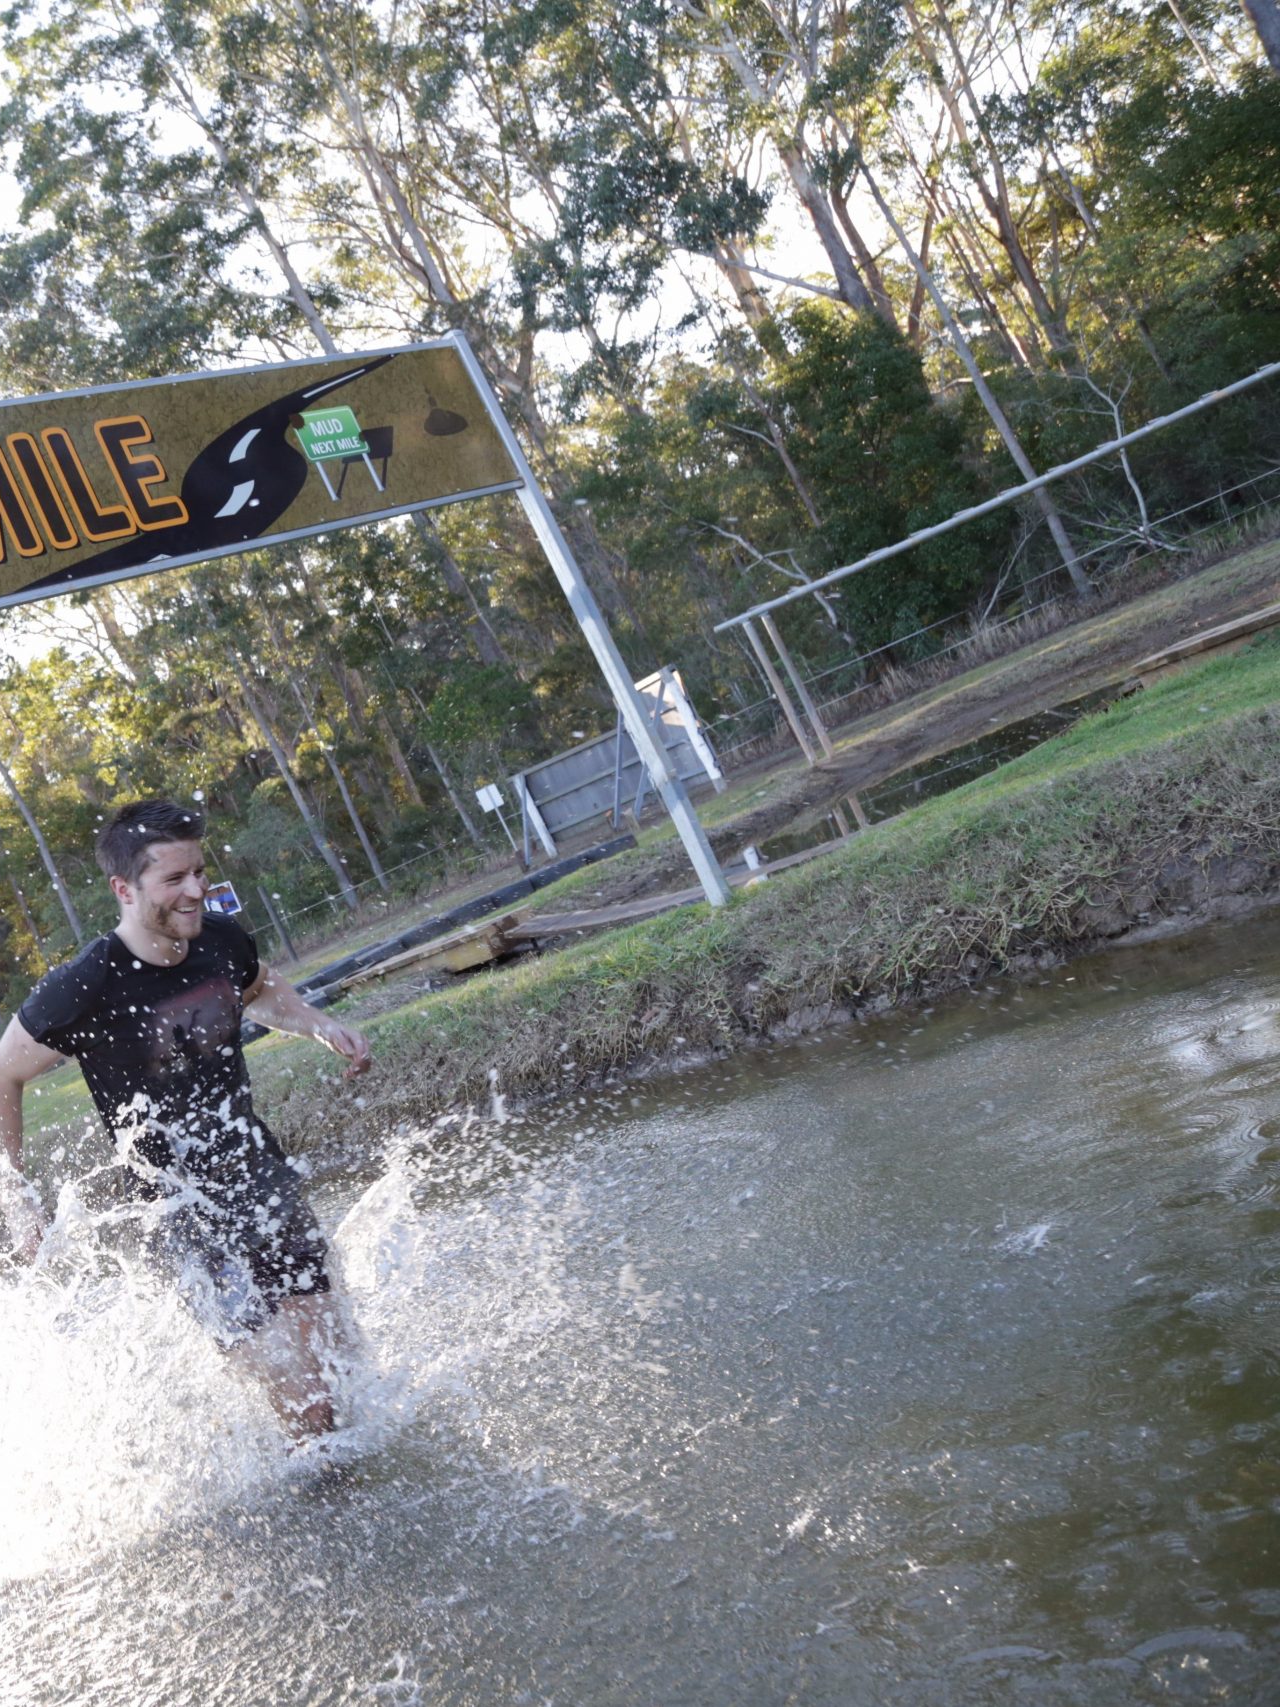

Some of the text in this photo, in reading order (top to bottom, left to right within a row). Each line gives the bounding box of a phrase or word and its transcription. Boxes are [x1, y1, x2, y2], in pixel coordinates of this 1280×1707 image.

[309, 418, 343, 437] MUD
[310, 436, 360, 455] NEXT MILE
